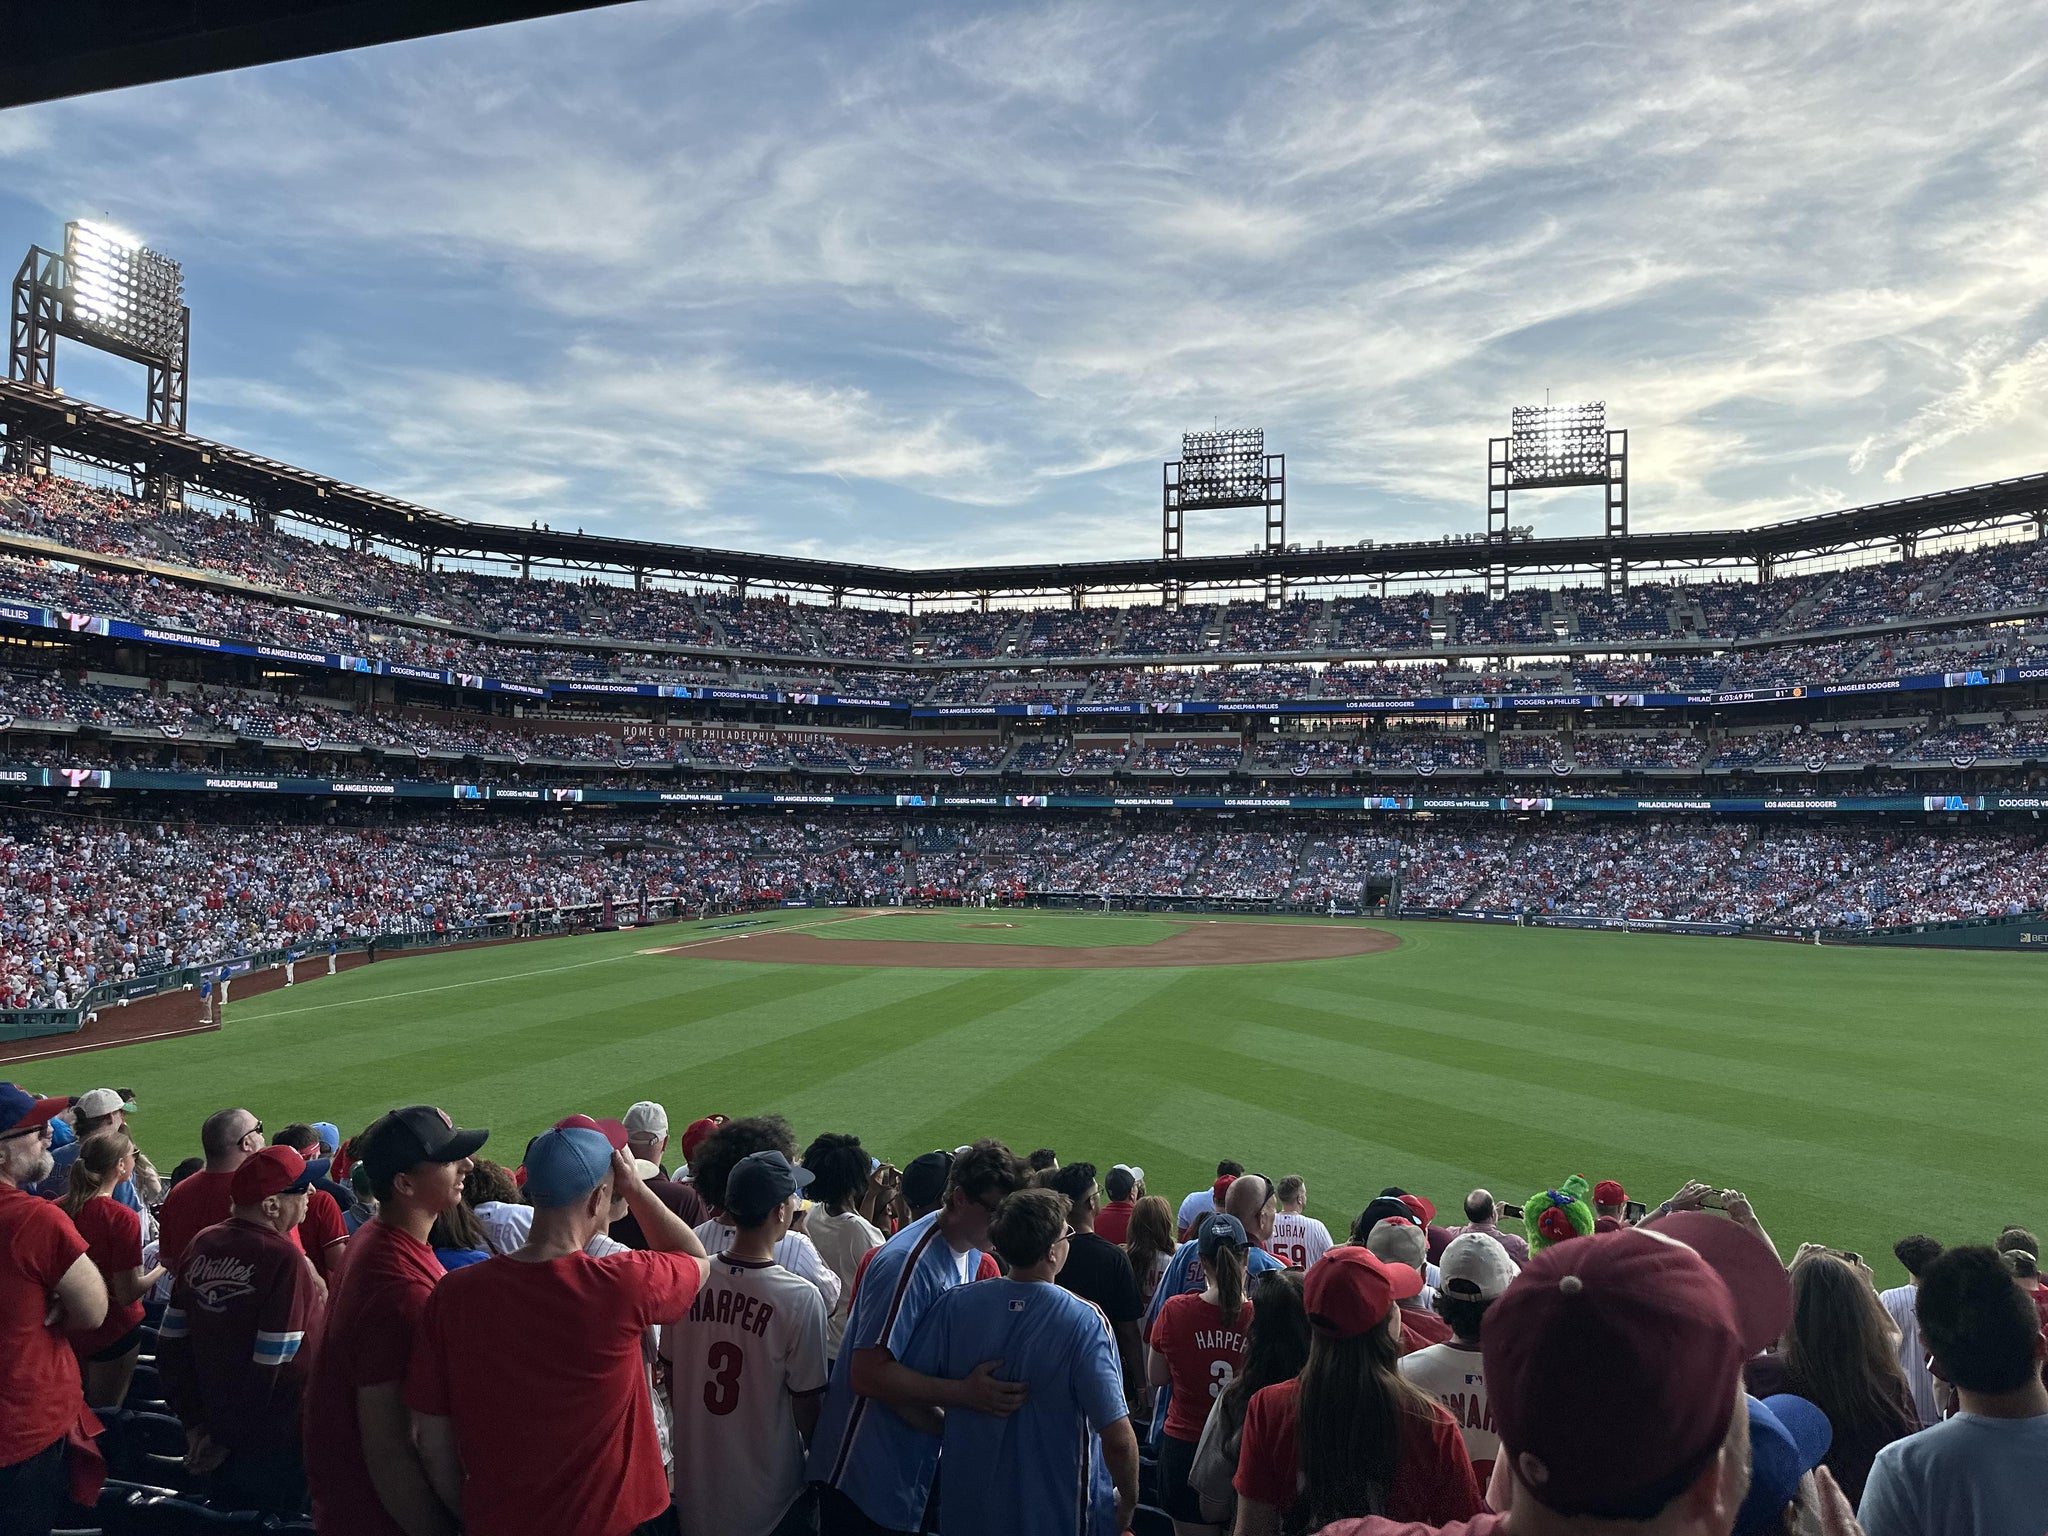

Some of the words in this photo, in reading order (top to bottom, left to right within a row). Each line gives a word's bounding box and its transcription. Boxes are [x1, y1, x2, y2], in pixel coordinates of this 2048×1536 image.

[0, 609, 29, 620] HILLIES
[144, 629, 192, 643] PHILADELPHIA
[193, 636, 220, 647] PHILLIES
[258, 646, 270, 655] LOS
[271, 649, 296, 659] ANGELES
[298, 652, 325, 663] DODGERS
[390, 666, 414, 676] DODGERS
[421, 670, 440, 680] PHILLIES
[2019, 669, 2048, 678] DODGE
[609, 685, 638, 693] DODGERS
[1837, 684, 1866, 692] ANGELES
[1867, 681, 1900, 690] DODGERS
[713, 691, 740, 699] DODGERS
[1719, 694, 1743, 702] 6:03:49
[623, 726, 653, 737] HOME
[678, 728, 697, 738] THE
[207, 779, 252, 788] PHILADELPHIA
[253, 781, 278, 789] PHILLIES
[185, 1255, 255, 1287] Phillies
[689, 1288, 774, 1338] HARPER
[704, 1341, 743, 1416] 3
[1209, 1360, 1233, 1398] 3
